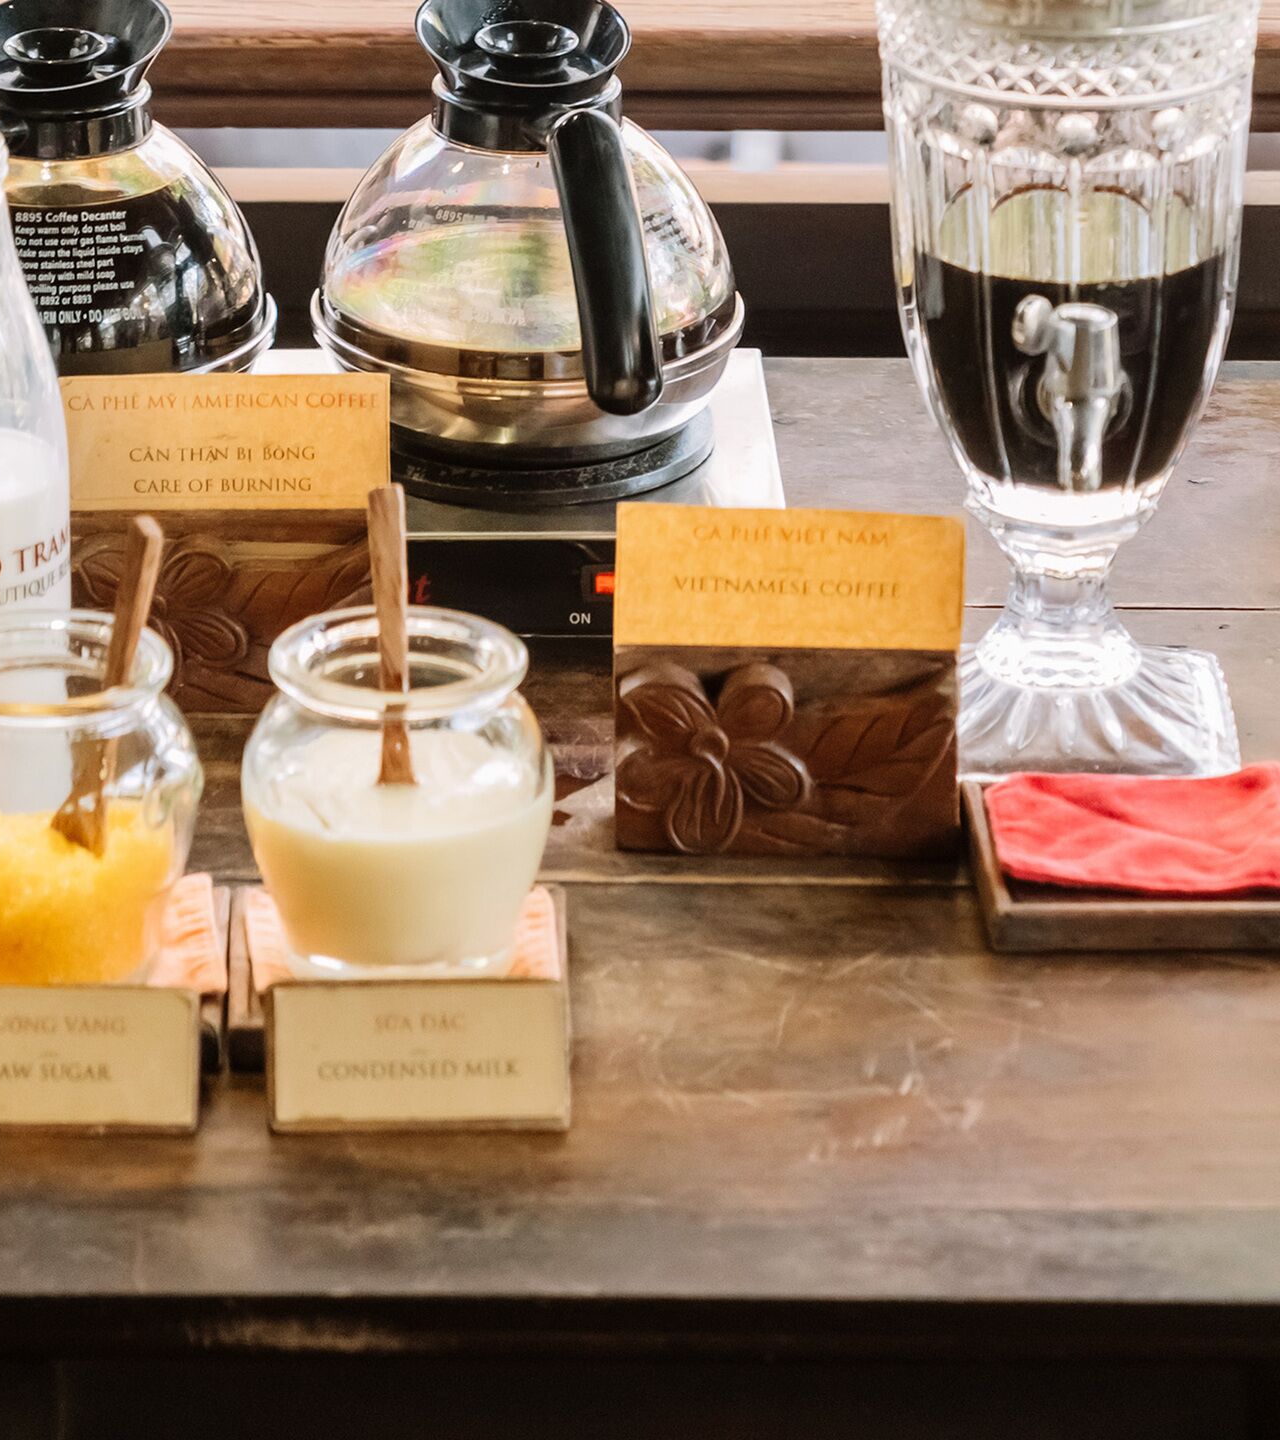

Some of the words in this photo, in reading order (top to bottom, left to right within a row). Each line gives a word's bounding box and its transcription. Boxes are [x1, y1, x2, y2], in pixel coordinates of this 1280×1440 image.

[15, 212, 42, 223] 8895
[45, 212, 79, 222] Coffee
[81, 210, 127, 221] Decanter
[15, 226, 35, 236] Keep
[37, 226, 59, 234] warm
[82, 224, 93, 234] do
[94, 223, 109, 232] not
[110, 222, 126, 232] boil
[15, 237, 27, 246] Do
[28, 238, 43, 246] not
[44, 238, 59, 246] use
[80, 237, 94, 247] gas
[38, 249, 55, 257] sure
[57, 248, 70, 257] the
[72, 247, 95, 259] liquid
[97, 246, 121, 255] inside
[122, 244, 143, 255] stays
[40, 260, 74, 269] stainless
[76, 259, 95, 269] steel
[97, 258, 114, 269] part
[38, 272, 56, 283] only
[57, 271, 75, 281] with
[76, 270, 94, 280] mild
[96, 270, 115, 280] soap
[59, 284, 91, 295] purpose
[92, 282, 119, 293] please
[120, 281, 135, 289] use
[62, 297, 71, 305] or
[58, 310, 82, 324] ONLY
[89, 310, 102, 323] DO
[191, 392, 299, 410] AMERICAN
[305, 391, 378, 409] COFFEE
[133, 478, 182, 494] CARE
[188, 478, 214, 493] OF
[220, 477, 313, 493] BURNING
[672, 574, 811, 597] VIETNAMESE
[819, 578, 901, 600] COFFEE
[569, 612, 591, 625] ON
[39, 1062, 112, 1082] SUGAR
[317, 1060, 458, 1081] CONDENSED
[464, 1057, 521, 1079] MILK
